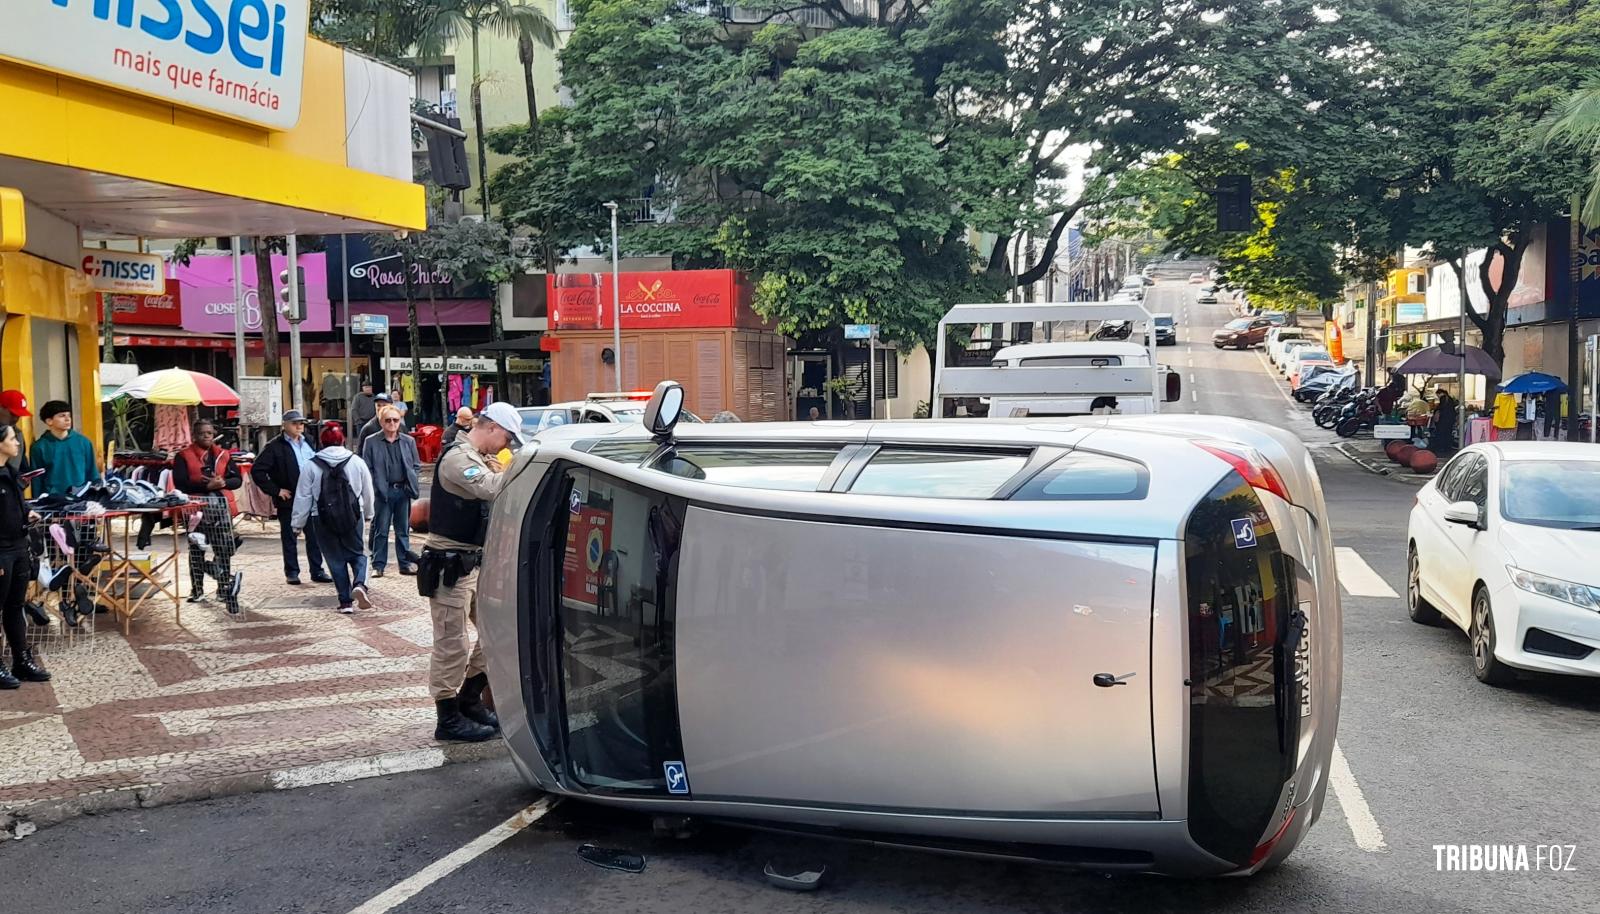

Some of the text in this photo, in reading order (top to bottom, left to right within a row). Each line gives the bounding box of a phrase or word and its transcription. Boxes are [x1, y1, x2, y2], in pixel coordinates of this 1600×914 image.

[113, 48, 279, 110] mais que farmácia
[101, 259, 155, 281] nissei
[367, 264, 405, 288] Rosa
[620, 302, 682, 314] LA COCCINA
[400, 361, 432, 370] BACA
